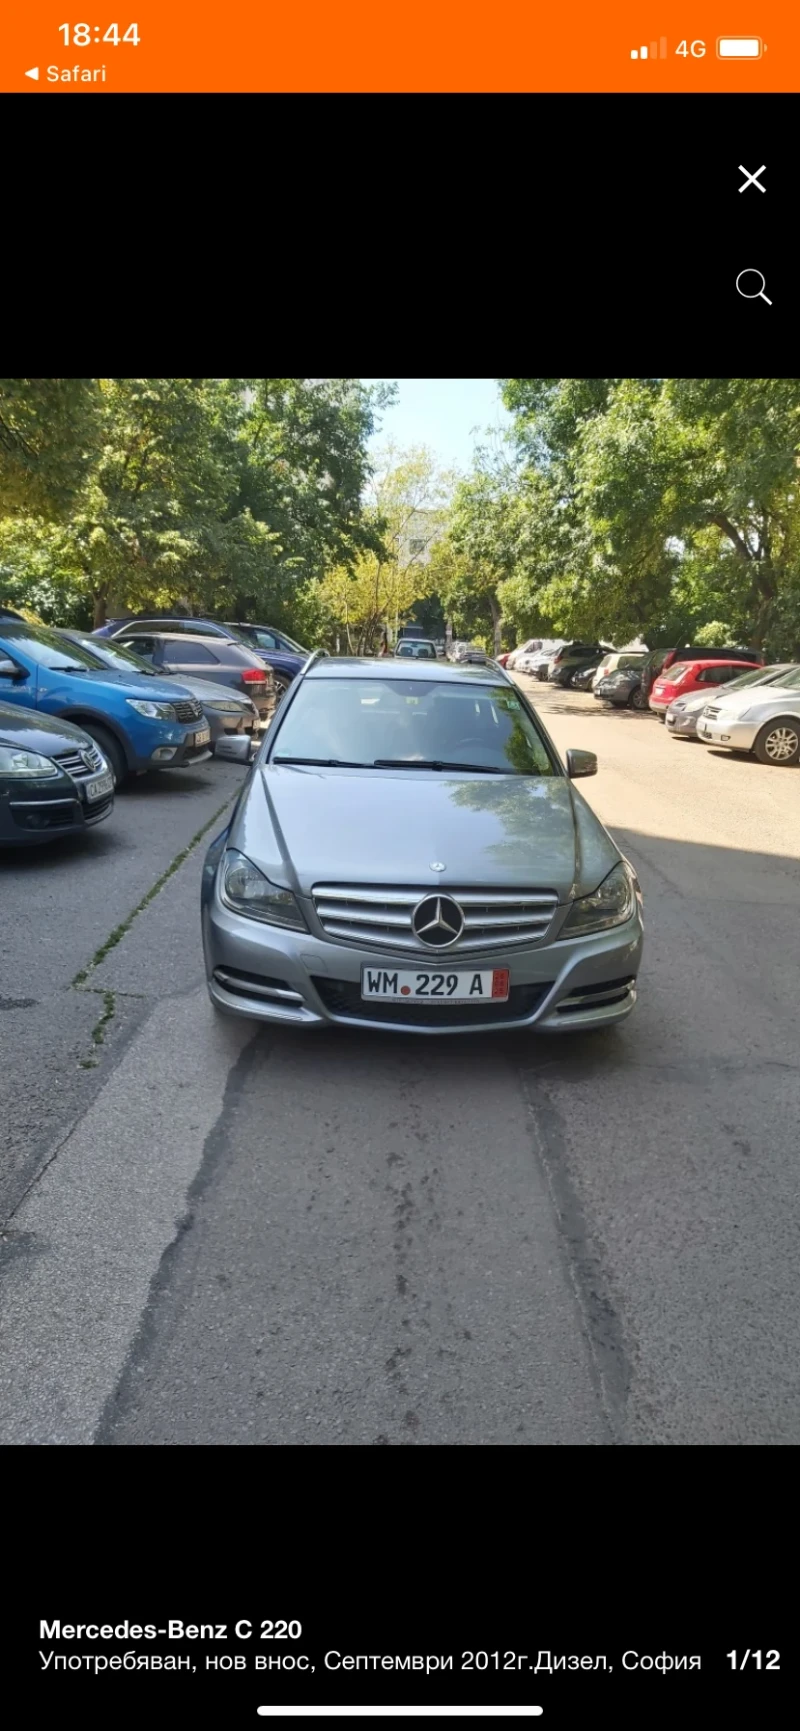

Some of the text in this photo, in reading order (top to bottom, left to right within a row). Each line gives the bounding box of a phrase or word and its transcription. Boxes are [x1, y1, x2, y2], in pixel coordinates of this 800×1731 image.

[367, 971, 399, 994] WM
[415, 974, 458, 996] 229
[469, 973, 484, 995] A
